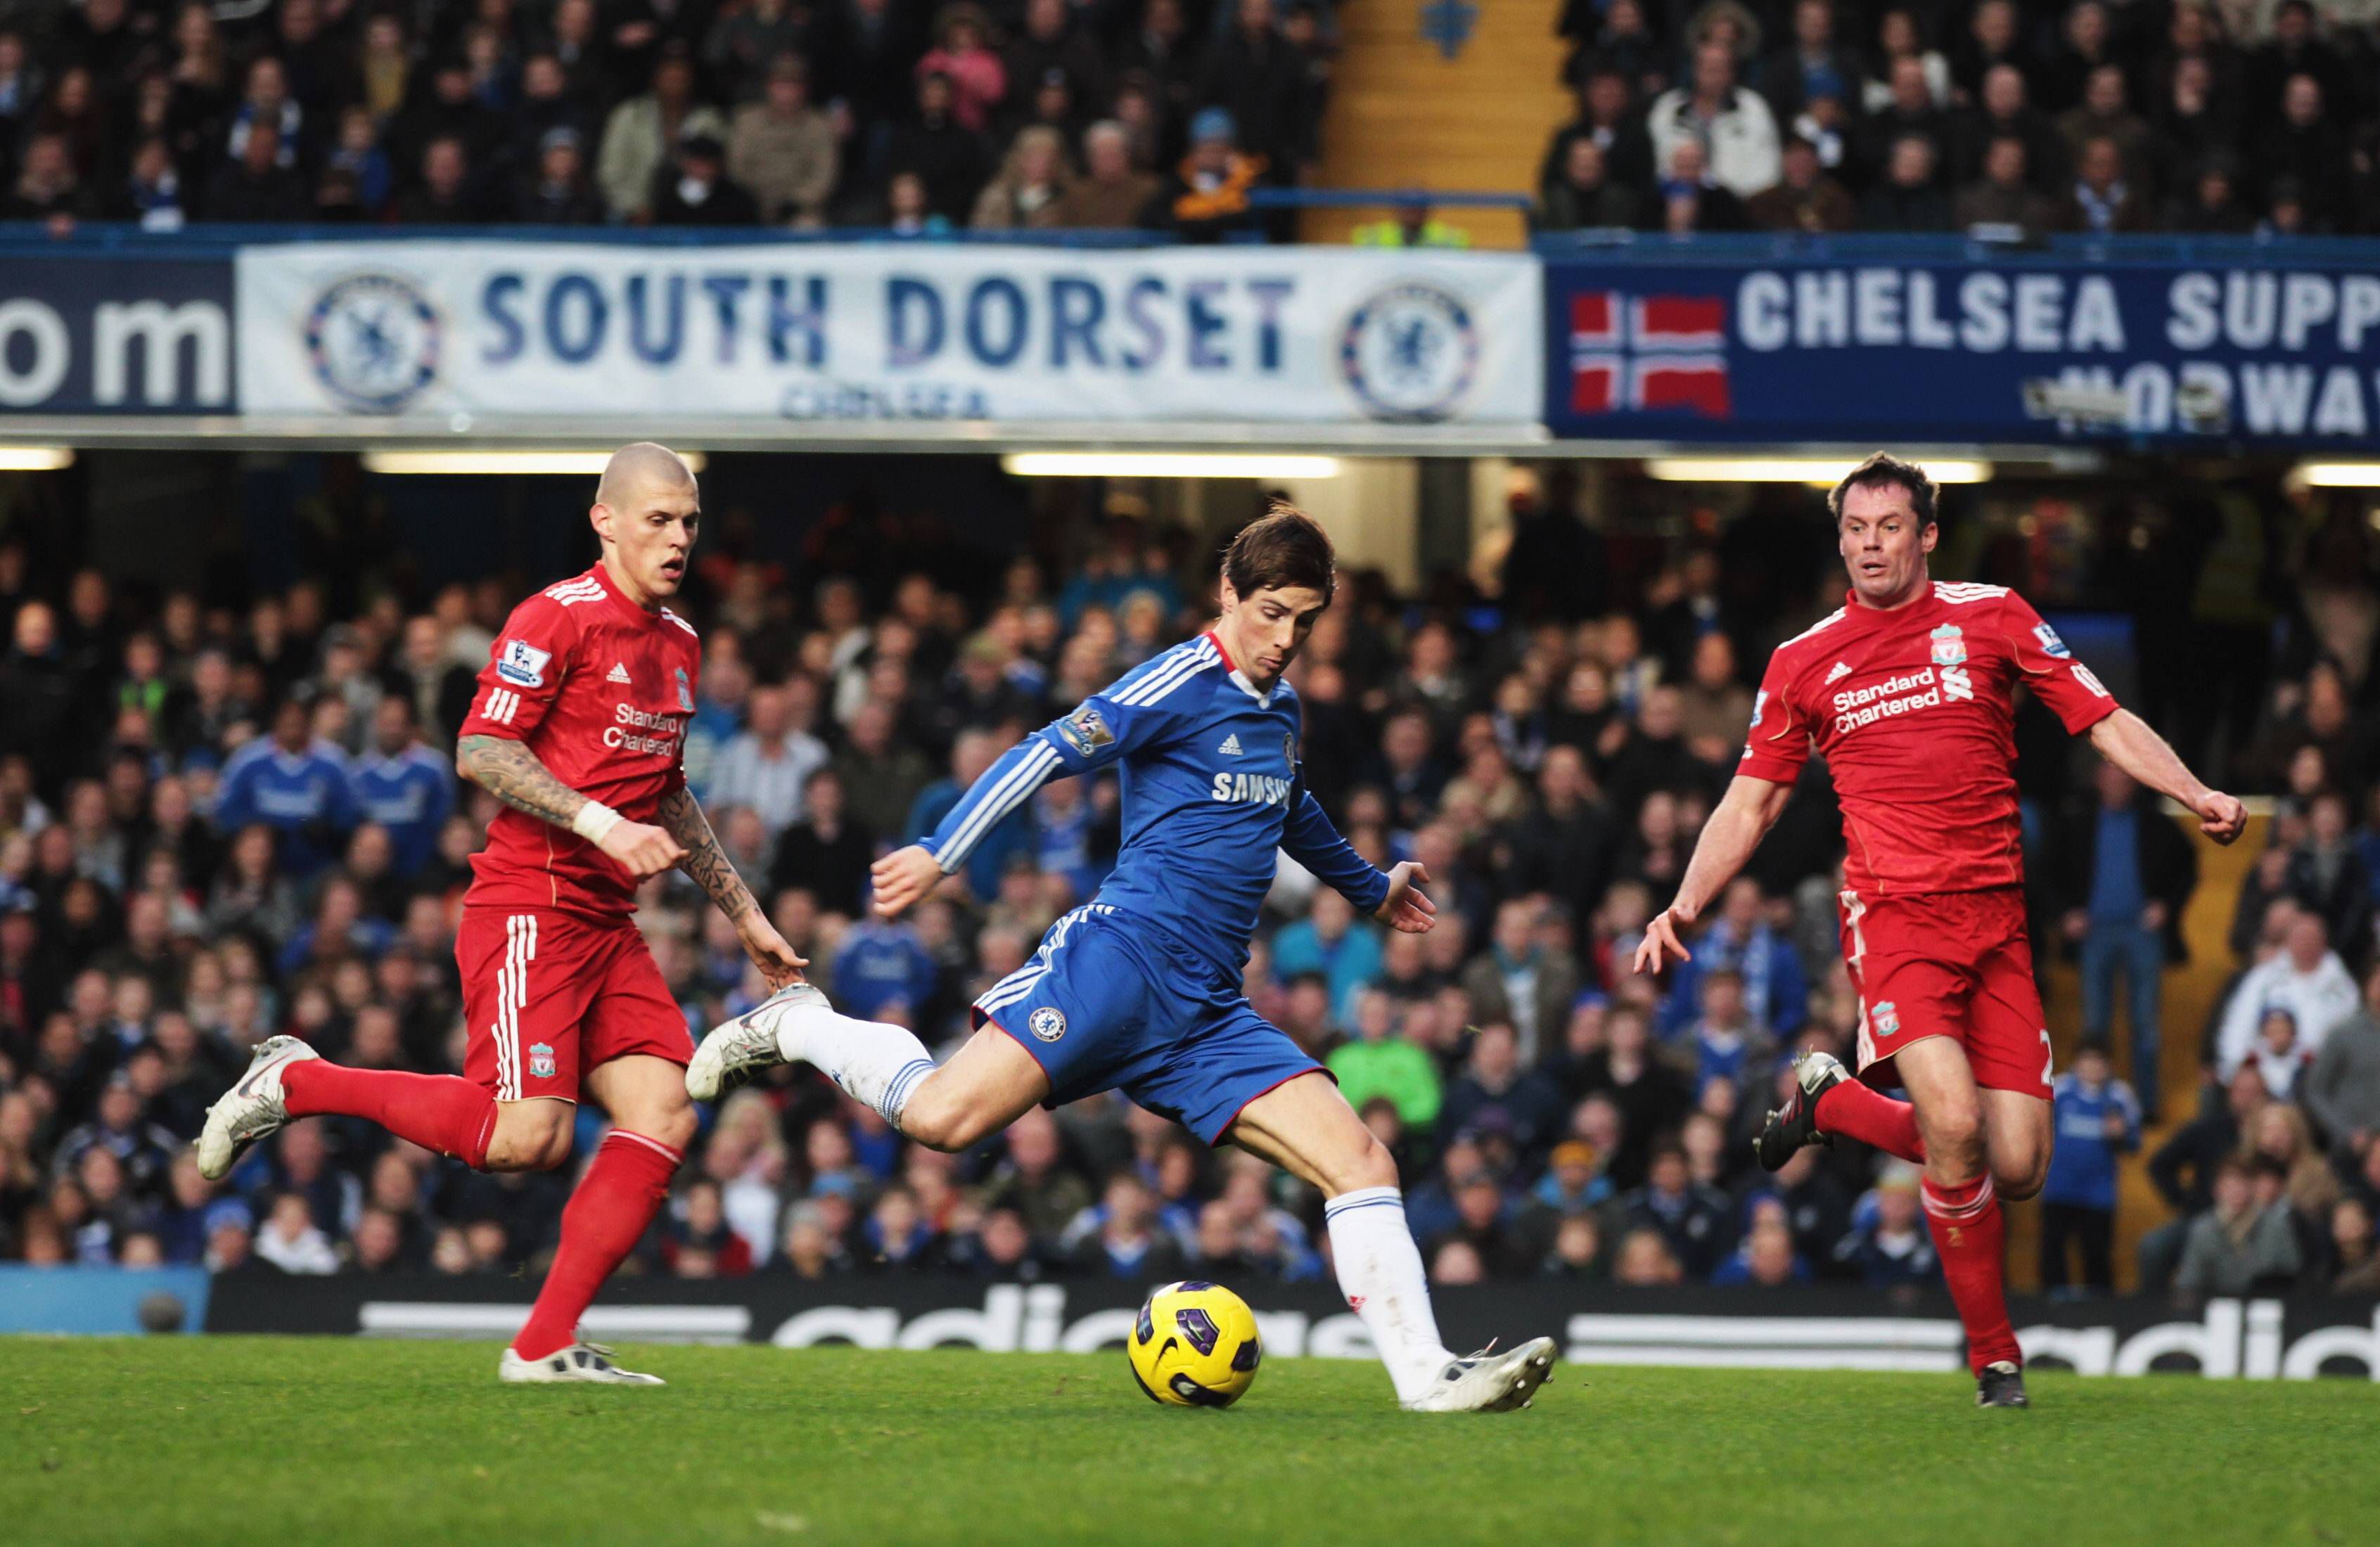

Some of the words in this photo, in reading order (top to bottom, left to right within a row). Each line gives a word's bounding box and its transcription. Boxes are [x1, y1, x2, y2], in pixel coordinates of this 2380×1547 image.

[482, 273, 826, 368] SOUTH
[886, 276, 1294, 370] DORSET
[1736, 269, 2125, 352] CHELSEA
[1833, 667, 1936, 712] Standard
[1835, 686, 1940, 734] Chartered
